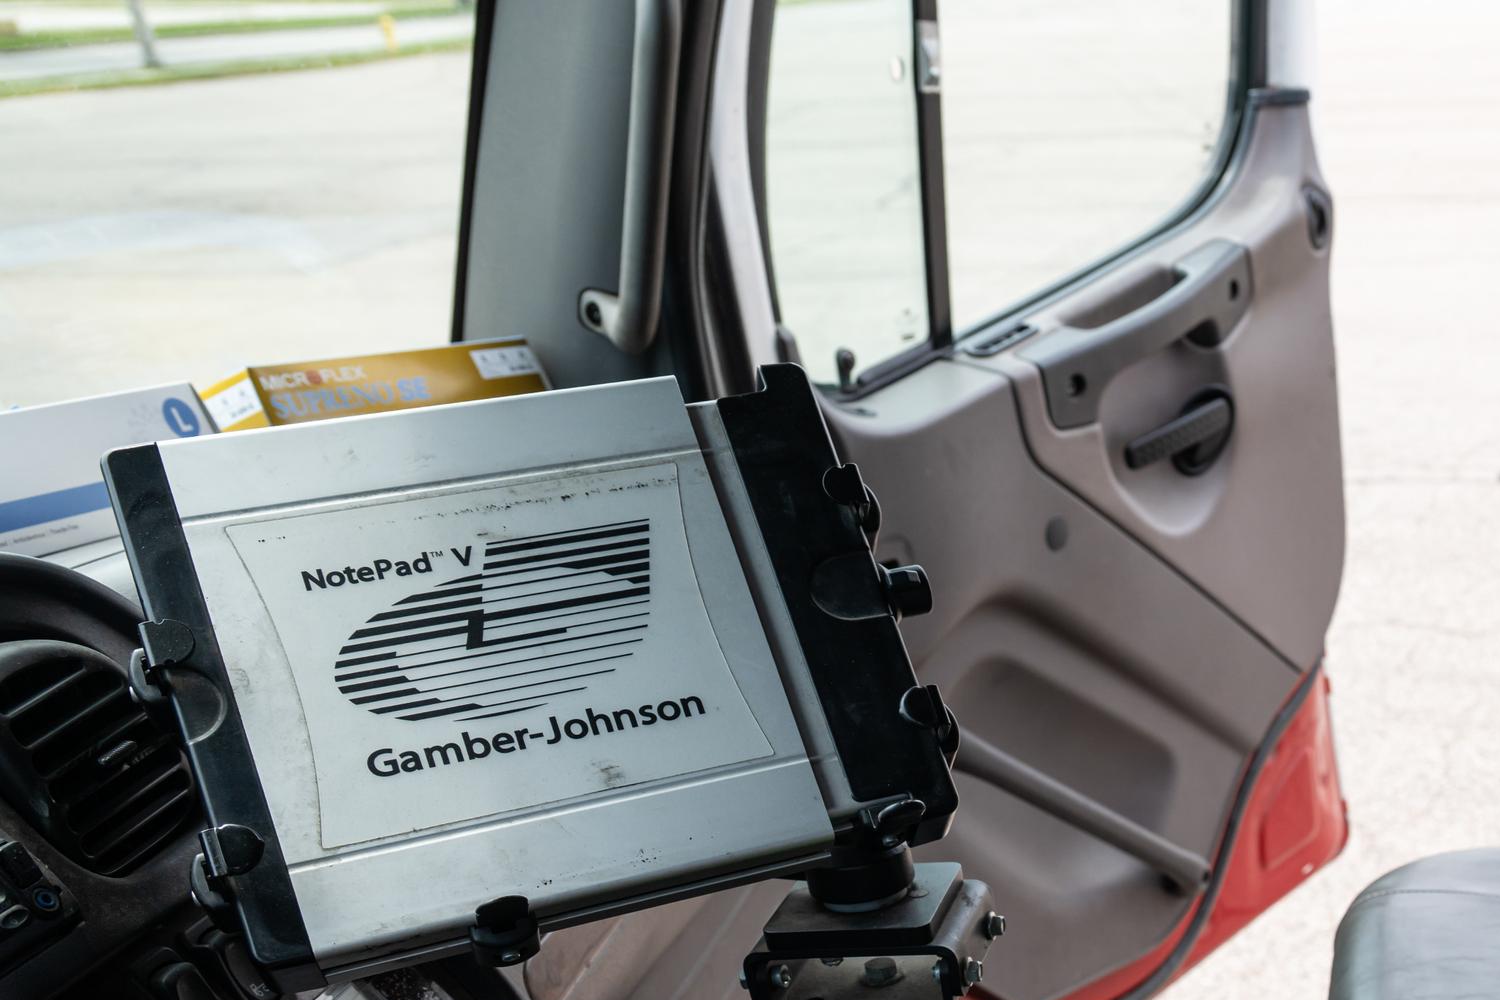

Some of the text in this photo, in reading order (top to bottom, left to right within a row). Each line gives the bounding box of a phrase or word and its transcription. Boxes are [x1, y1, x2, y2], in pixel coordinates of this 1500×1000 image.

[269, 380, 391, 419] SUPRENO
[400, 377, 432, 400] SE
[170, 407, 194, 432] L
[451, 546, 472, 567] V
[366, 695, 706, 777] Gamber-Johnson
